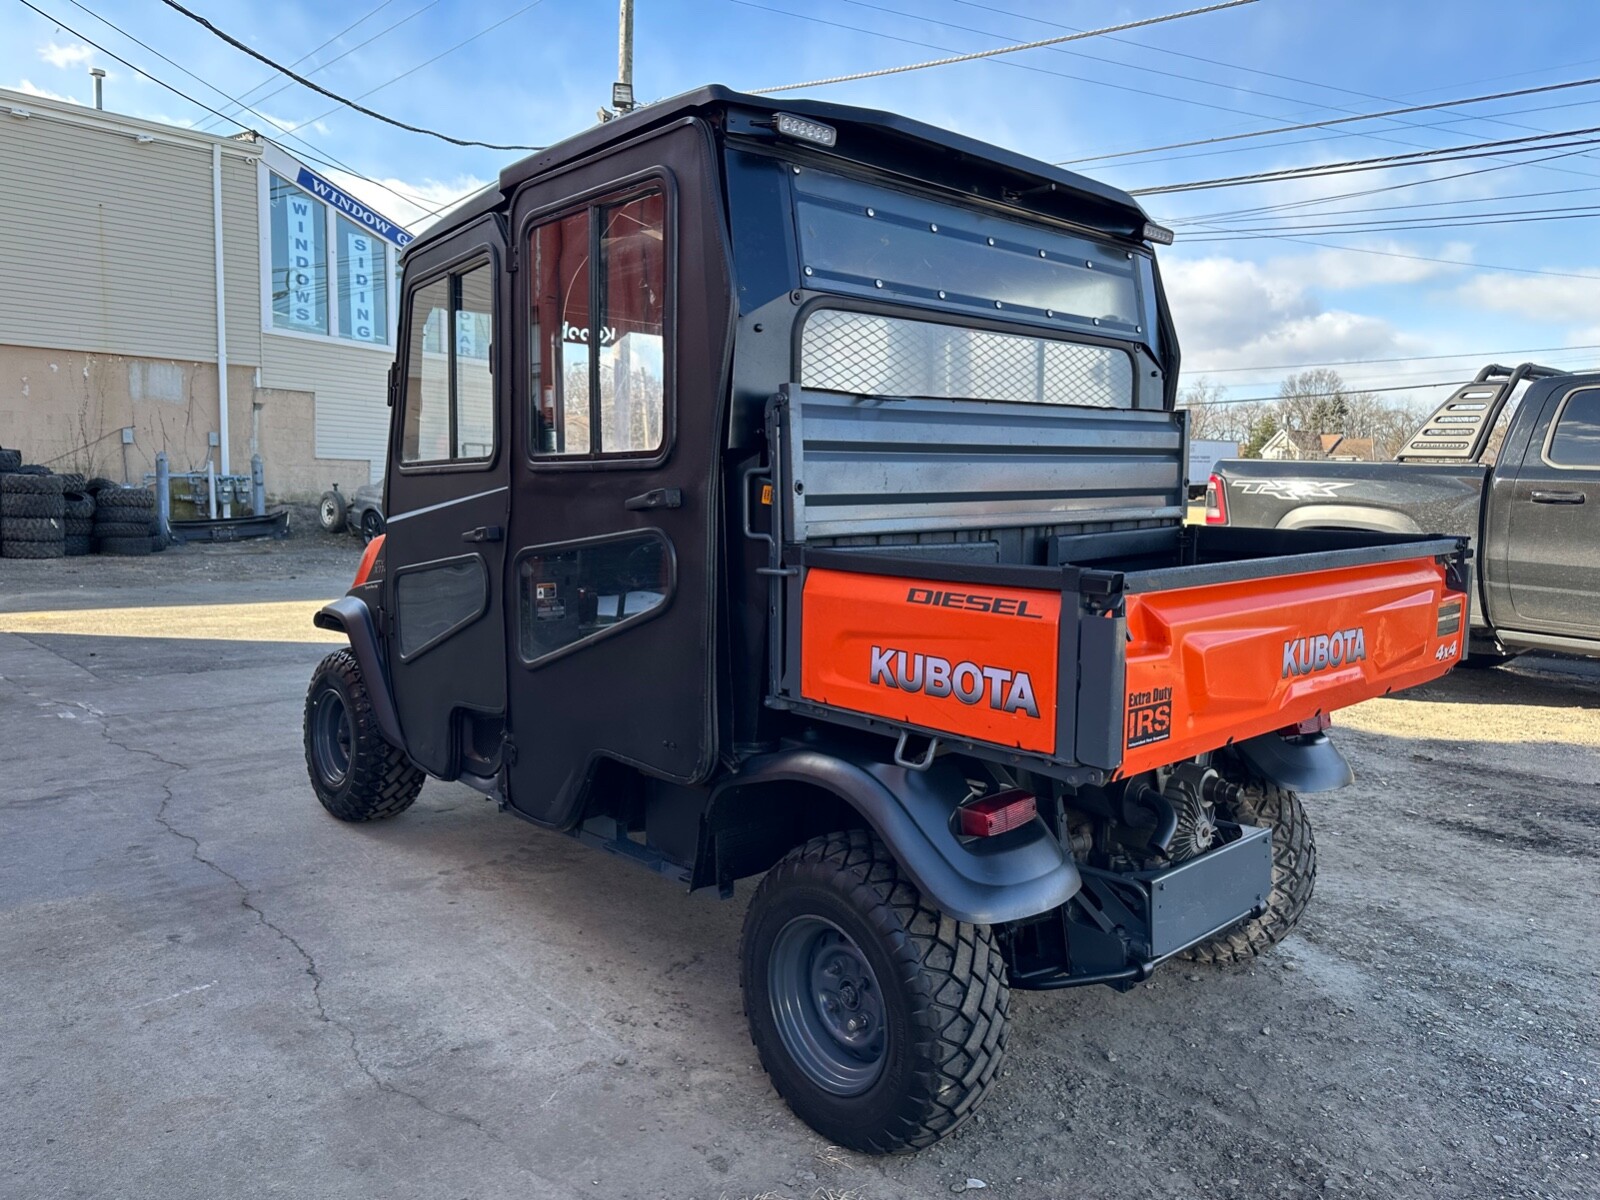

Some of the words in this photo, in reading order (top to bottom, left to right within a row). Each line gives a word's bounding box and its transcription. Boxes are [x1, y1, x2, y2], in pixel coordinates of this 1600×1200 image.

[312, 178, 390, 234] WINDOW
[292, 202, 311, 322] WINDOWS
[354, 239, 371, 338] SIDING
[906, 587, 1042, 619] DIESEL
[1281, 628, 1366, 678] KUBOTA
[1435, 640, 1457, 661] 4x4
[869, 645, 1041, 719] KUBOTA
[1128, 691, 1151, 707] Extra
[1152, 686, 1172, 702] Duty
[1128, 705, 1170, 739] IRS
